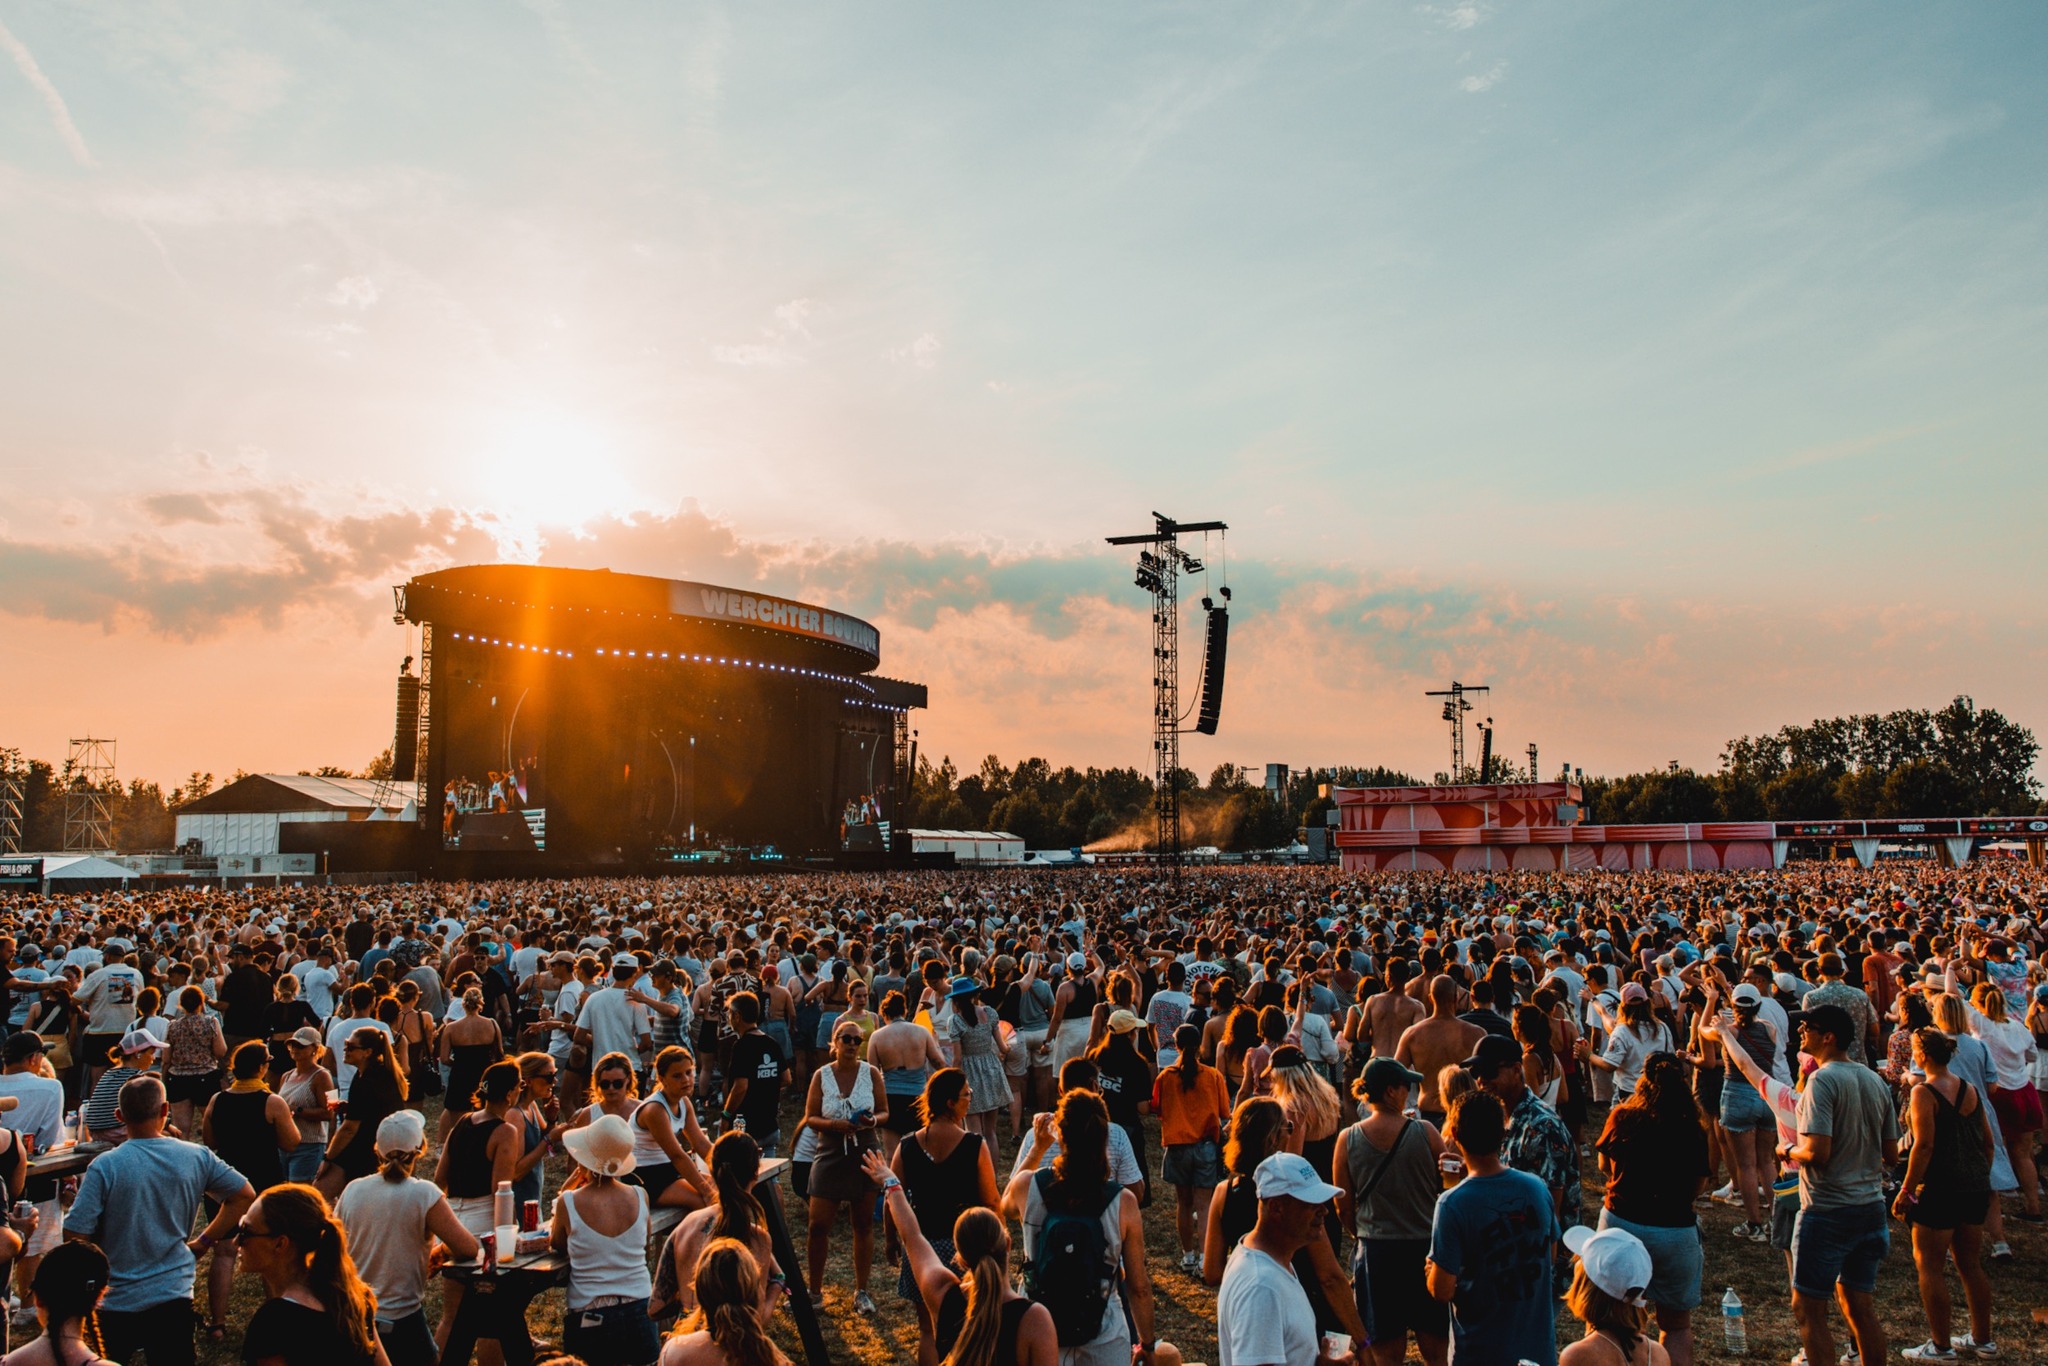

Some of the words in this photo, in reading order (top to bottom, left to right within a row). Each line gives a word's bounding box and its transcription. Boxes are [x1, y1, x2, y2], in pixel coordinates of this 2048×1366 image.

[701, 589, 819, 633] WERCHTER
[823, 613, 877, 652] BOUTIQUE
[1898, 824, 1925, 832] DRINKS
[2034, 822, 2044, 830] 22
[11, 864, 16, 874] &
[16, 864, 32, 874] CHIPS
[1186, 965, 1202, 979] HOT
[757, 1068, 778, 1079] KBC
